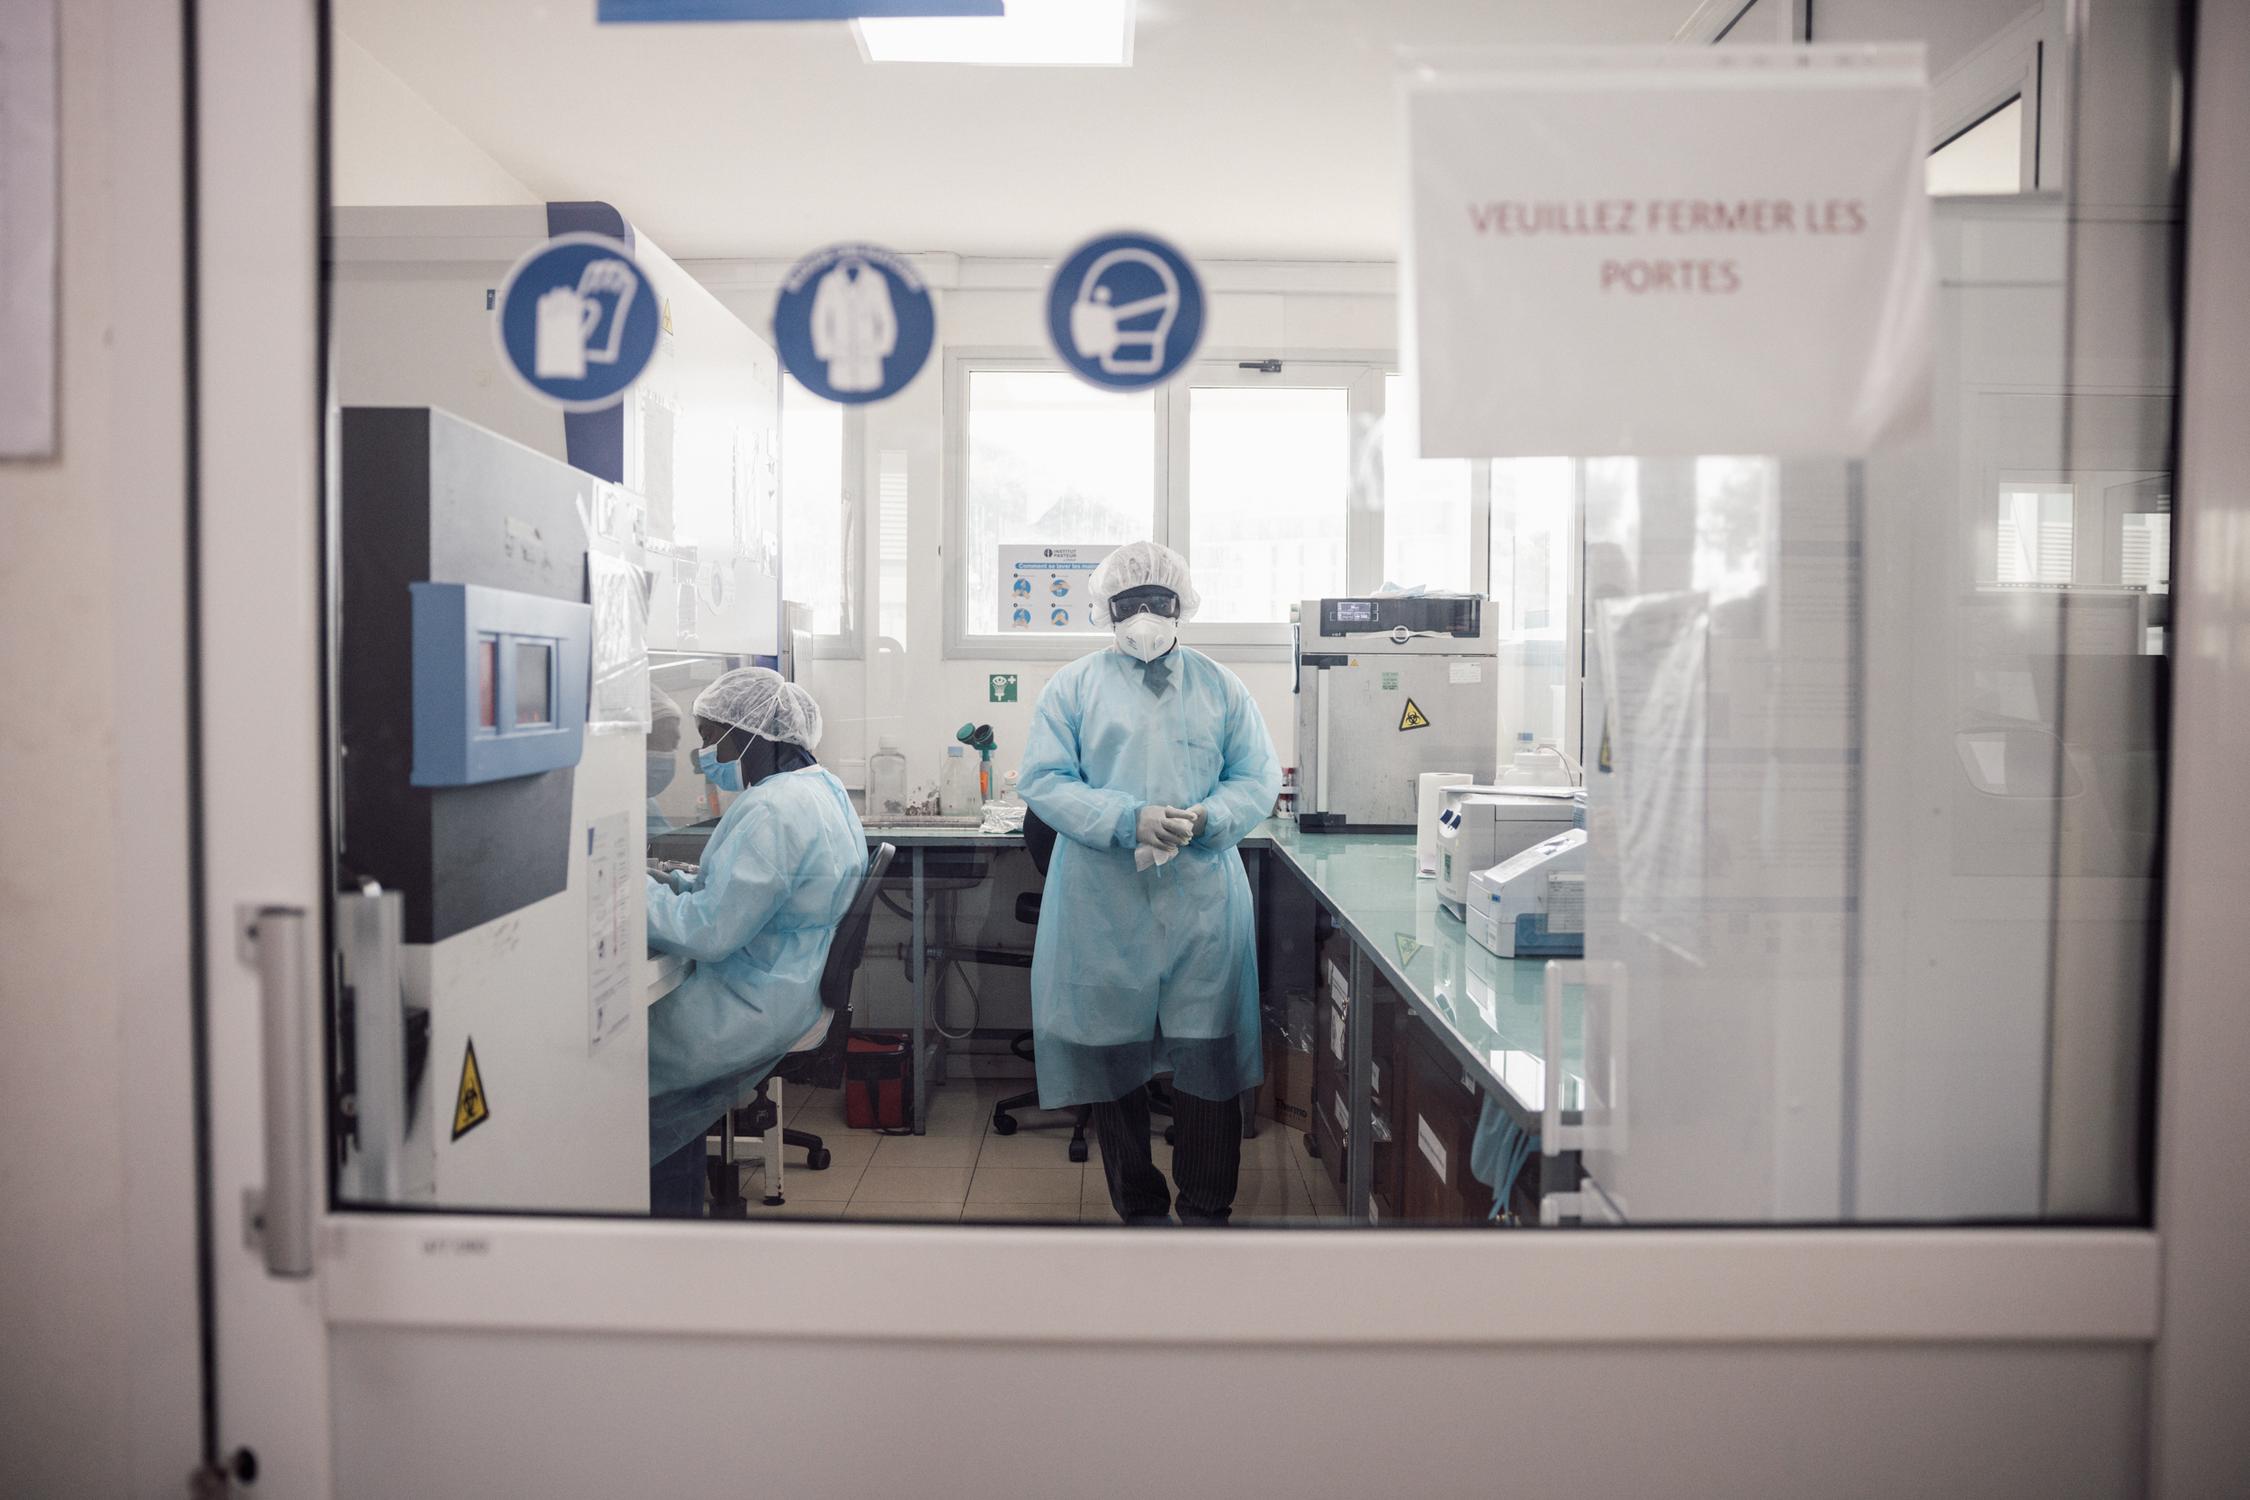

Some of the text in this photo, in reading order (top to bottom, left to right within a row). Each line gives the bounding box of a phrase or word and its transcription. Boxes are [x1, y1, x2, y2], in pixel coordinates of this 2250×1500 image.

[1467, 199, 1868, 235] VEUILLEZ FERMER LES
[1601, 259, 1742, 295] PORTES
